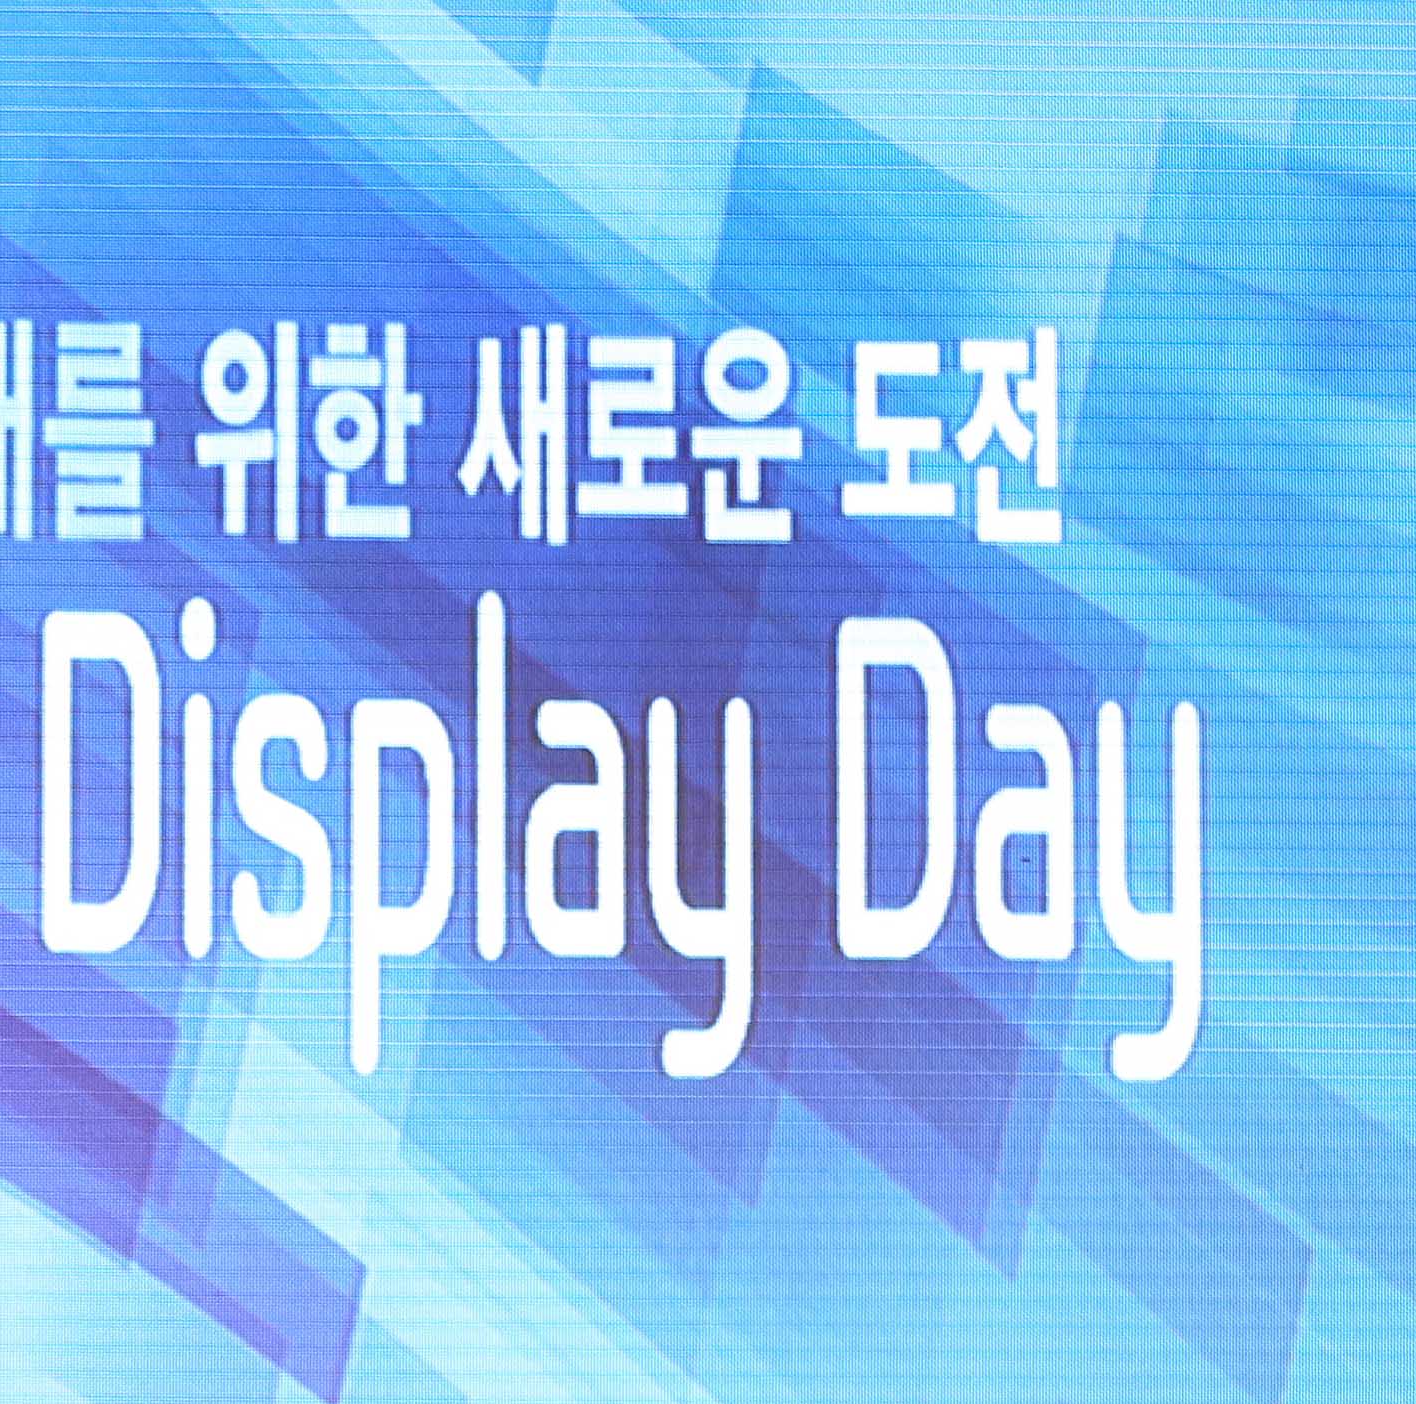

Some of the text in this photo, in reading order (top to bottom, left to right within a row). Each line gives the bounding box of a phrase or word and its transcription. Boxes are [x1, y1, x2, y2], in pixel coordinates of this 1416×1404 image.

[194, 318, 424, 543] 위한
[456, 323, 803, 545] 새로운
[837, 325, 1063, 545] 도전
[40, 589, 754, 1077] Display
[834, 615, 1203, 1083] Day
